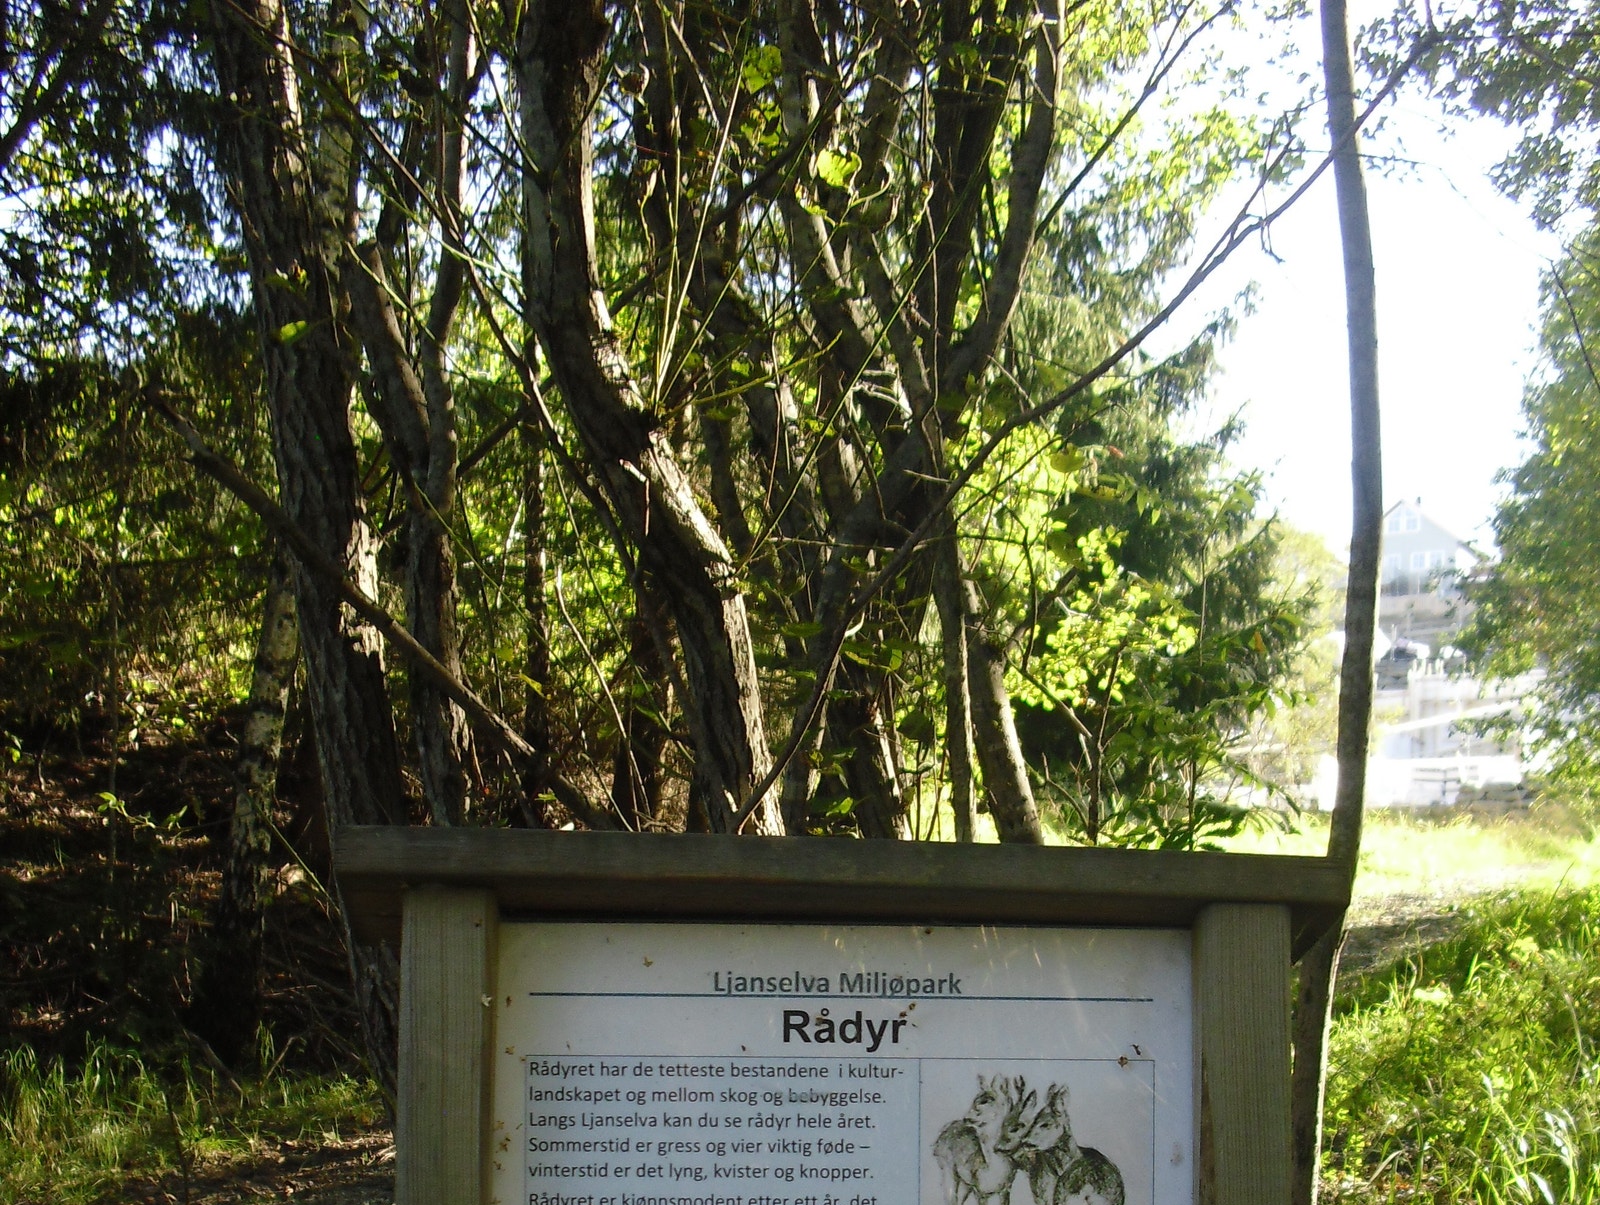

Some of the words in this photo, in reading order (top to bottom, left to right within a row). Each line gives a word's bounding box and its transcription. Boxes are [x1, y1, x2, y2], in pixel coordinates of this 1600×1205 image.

[712, 971, 831, 997] Ljanselva
[838, 972, 963, 997] Miljøpark
[783, 1008, 908, 1053] Rådyr
[530, 1061, 595, 1079] Rådyret
[600, 1061, 628, 1076] har
[633, 1062, 653, 1076] de
[658, 1064, 725, 1077] tetteste
[731, 1062, 829, 1078] bestandene
[849, 1063, 903, 1078] kultur-
[530, 1086, 621, 1105] landskapet
[626, 1091, 646, 1105] og
[652, 1087, 714, 1102] mellom
[720, 1088, 758, 1106] skog
[763, 1092, 783, 1106] og
[530, 1112, 575, 1130] Langs
[582, 1112, 657, 1130] Ljanselva
[663, 1112, 692, 1127] kan
[698, 1113, 718, 1127] du
[725, 1117, 742, 1128] se
[748, 1112, 791, 1131] rådyr
[797, 1113, 832, 1128] hele
[838, 1113, 875, 1128] året.
[528, 1138, 629, 1152] Sommerstid
[636, 1142, 653, 1152] er
[658, 1142, 700, 1156] gress
[706, 1142, 726, 1156] og
[731, 1139, 763, 1153] vier
[768, 1138, 812, 1157] viktig
[817, 1138, 855, 1155] føde
[528, 1163, 608, 1177] vinterstid
[614, 1167, 631, 1177] er
[636, 1163, 663, 1178] det
[669, 1163, 707, 1181] lyng,
[714, 1163, 770, 1178] kvister
[774, 1168, 794, 1182] og
[800, 1164, 873, 1182] knopper.
